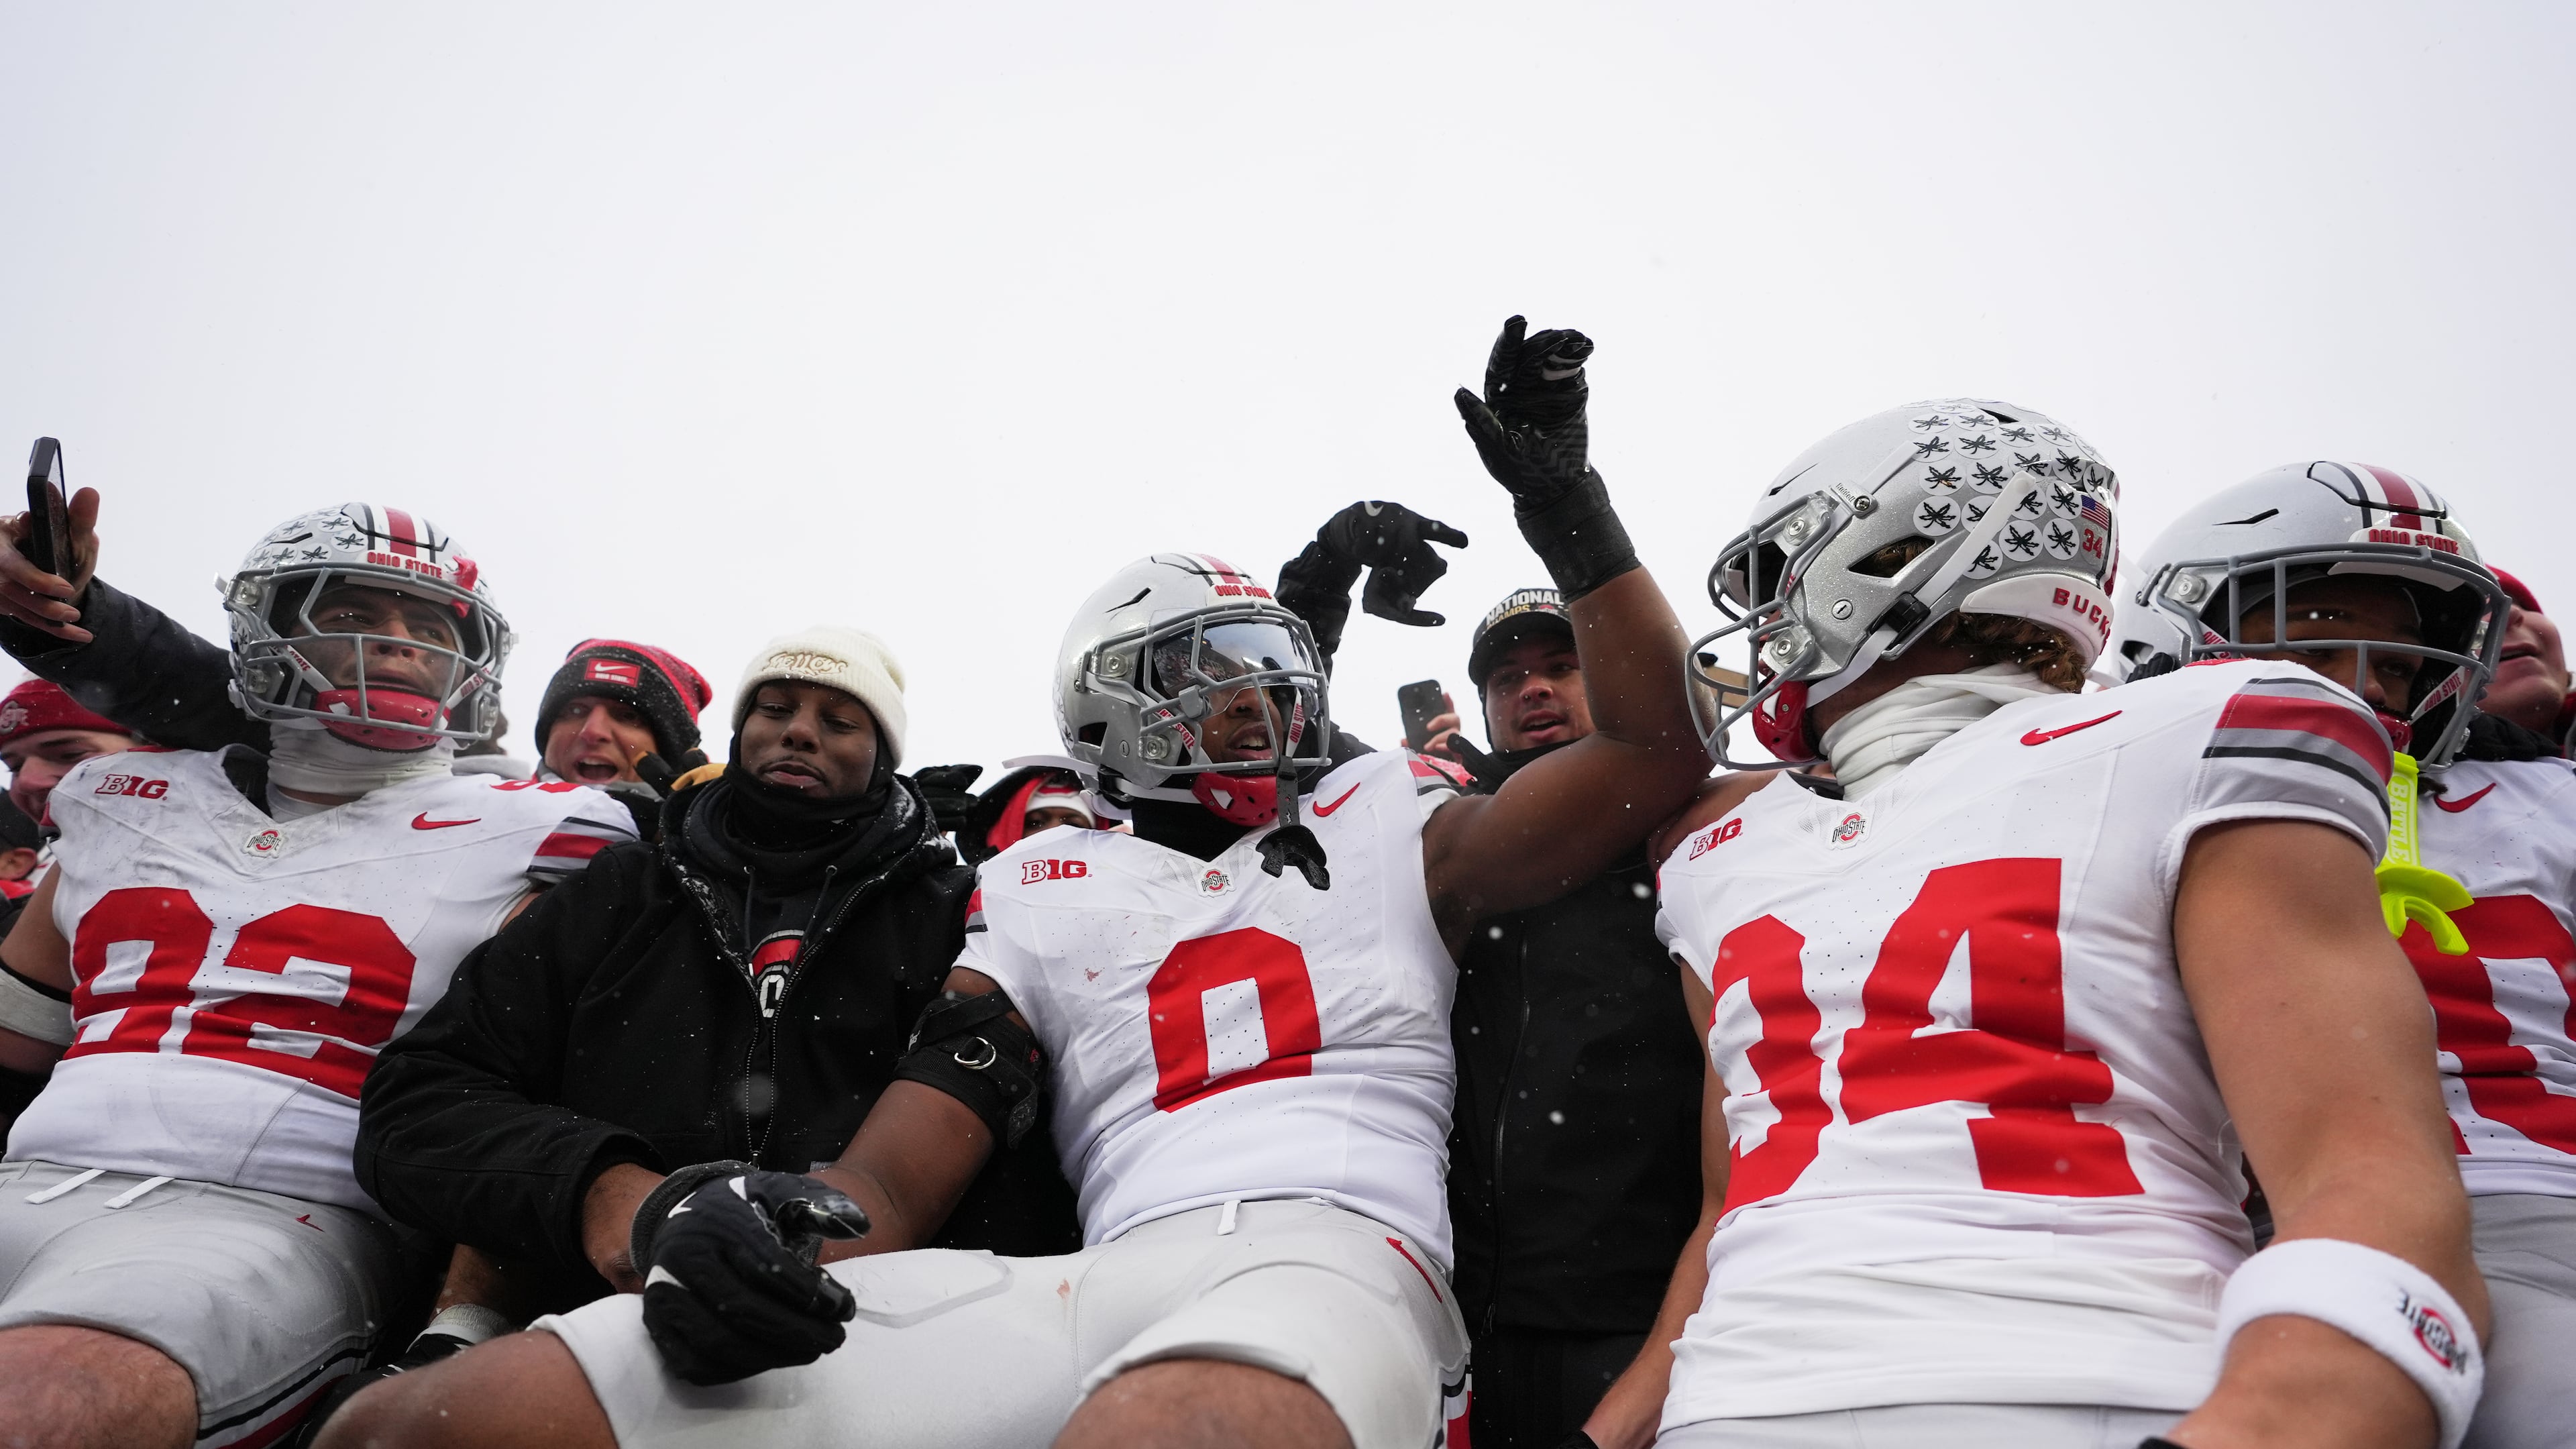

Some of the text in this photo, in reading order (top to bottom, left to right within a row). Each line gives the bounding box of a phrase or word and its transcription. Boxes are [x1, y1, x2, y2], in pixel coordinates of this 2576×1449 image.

[2082, 528, 2103, 559] 34
[2369, 529, 2459, 555] OHIO STATE
[367, 551, 443, 579] OHIO STATE
[1215, 585, 1272, 600] OHIO STATE
[1485, 590, 1564, 625] NATIONAL
[2053, 588, 2110, 655] BUCK
[2443, 673, 2461, 697] STATE
[1290, 722, 1303, 744] OHIO
[2390, 781, 2410, 863] BATTLE
[64, 887, 417, 1099] 92
[1146, 926, 1322, 1114] 0
[1709, 858, 2145, 1232] 34
